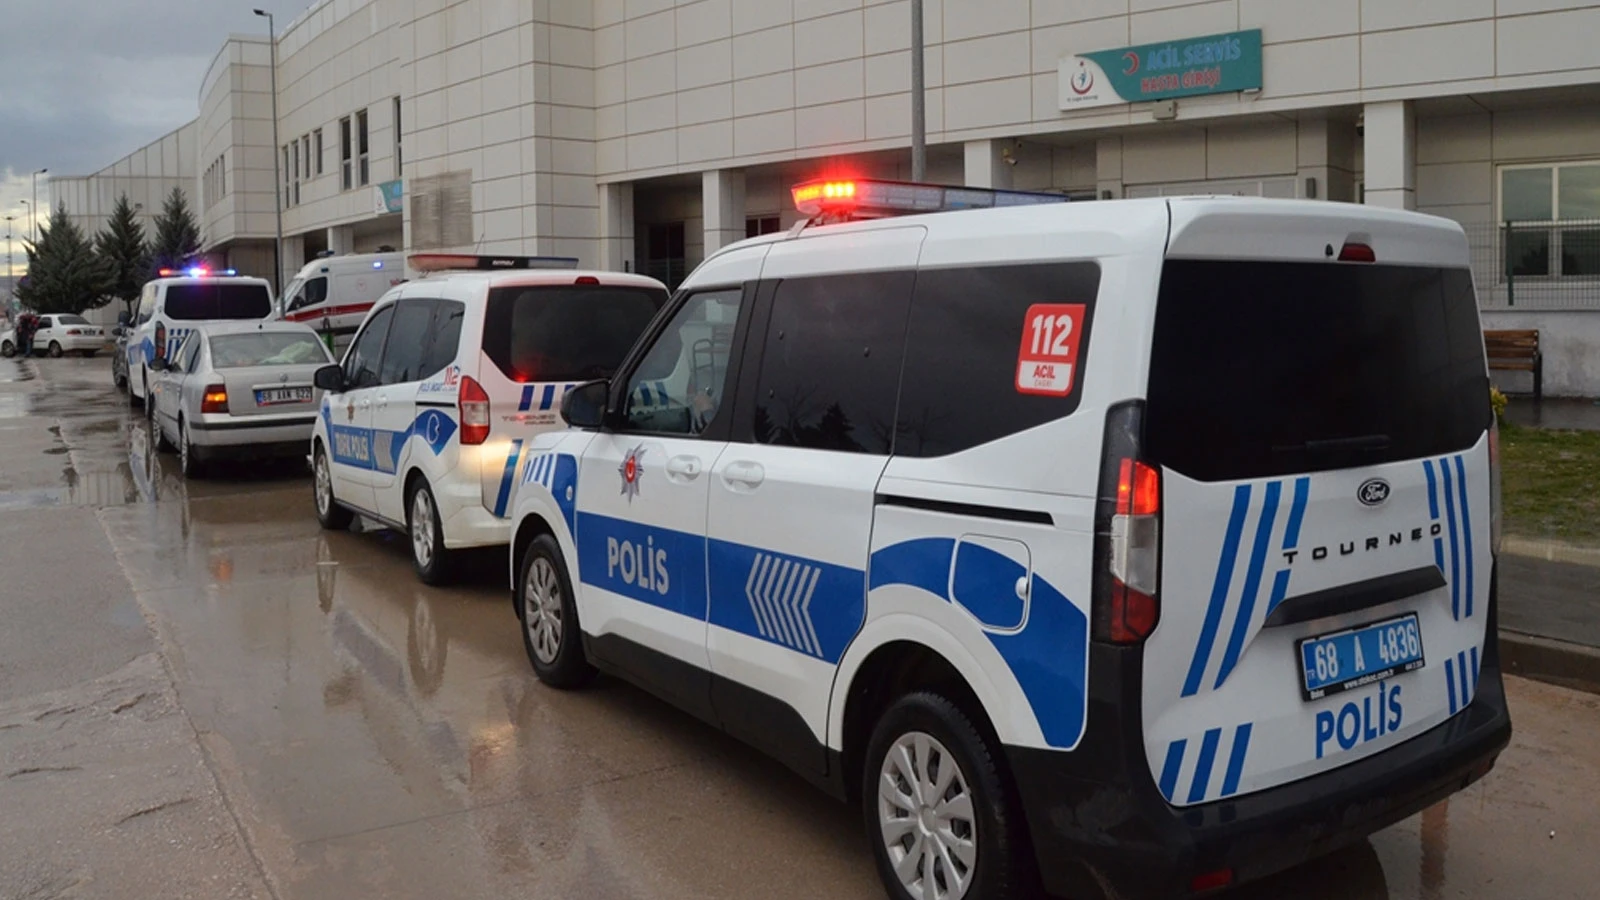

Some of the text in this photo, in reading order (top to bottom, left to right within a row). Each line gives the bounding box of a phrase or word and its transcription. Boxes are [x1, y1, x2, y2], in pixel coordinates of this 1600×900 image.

[1147, 37, 1242, 71] ACİL SERVİS
[1141, 74, 1180, 93] HASTA
[1031, 314, 1073, 356] 112
[1361, 481, 1389, 502] Ford
[607, 535, 669, 595] POLİS
[1283, 523, 1442, 565] TOURNEO
[1315, 642, 1339, 681] 68
[1353, 635, 1366, 672] A
[1378, 622, 1418, 664] 4836
[1315, 680, 1403, 760] POLİS
